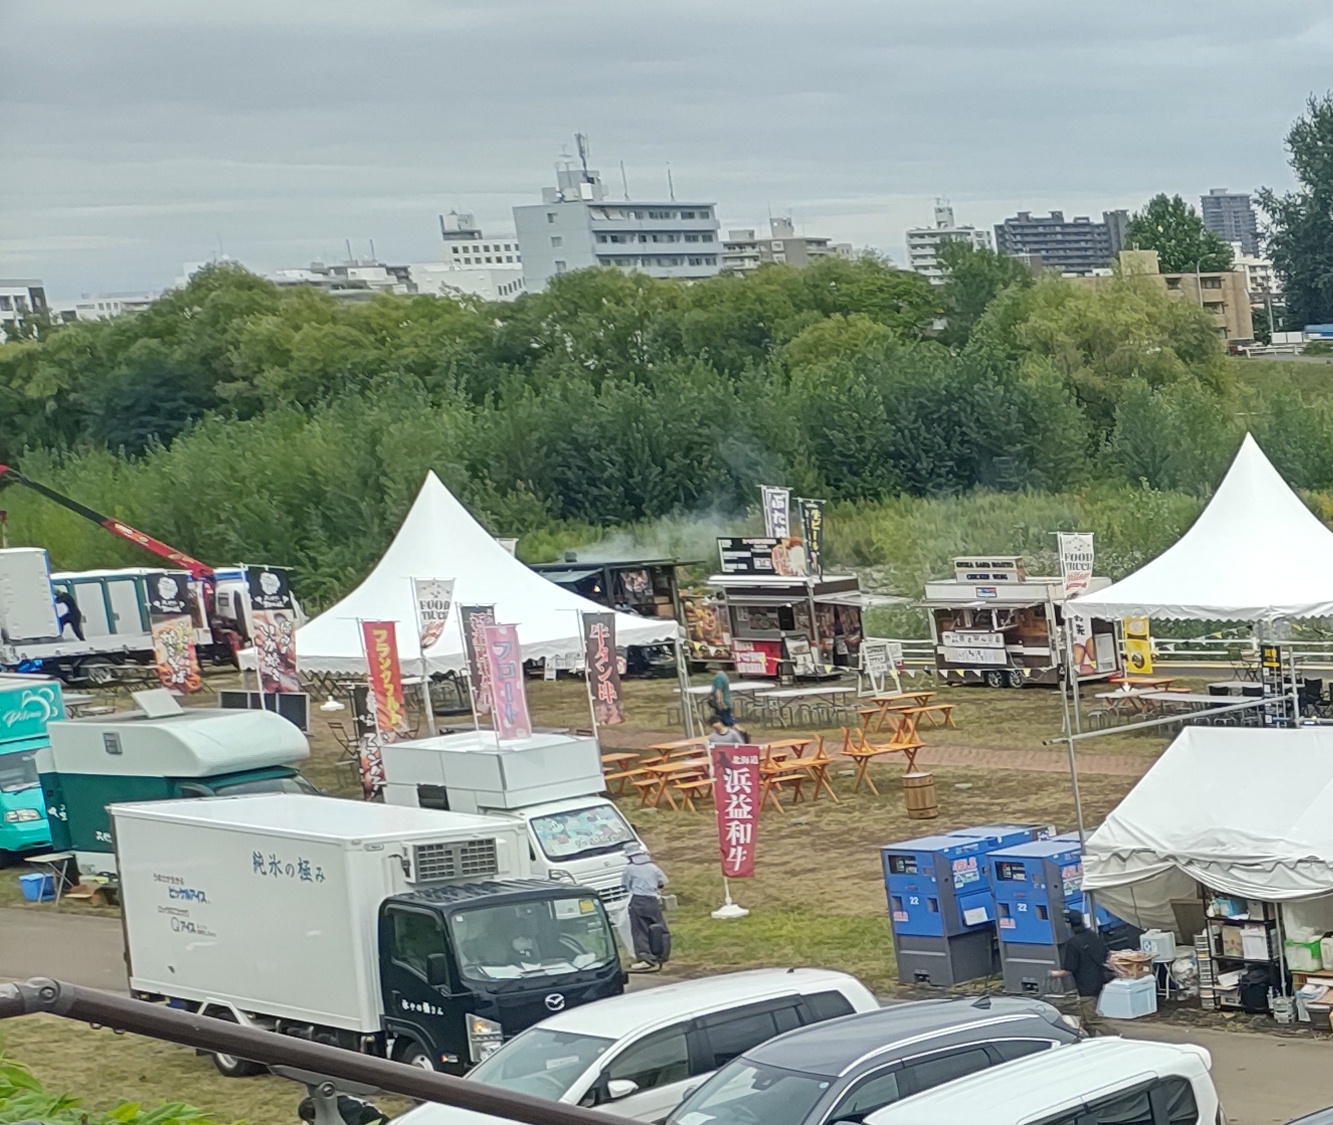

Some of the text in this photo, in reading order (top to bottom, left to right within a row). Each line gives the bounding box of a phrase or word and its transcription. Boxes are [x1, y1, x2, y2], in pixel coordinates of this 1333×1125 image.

[1064, 553, 1093, 562] FOOD
[1065, 562, 1092, 571] TRUCK
[419, 600, 451, 610] FOOD
[590, 623, 618, 705] 牛タン串
[372, 629, 402, 725] フランクフルト
[492, 640, 520, 726] フロート
[731, 755, 759, 765] 北海道
[723, 767, 754, 872] 浜益和牛
[252, 851, 326, 884] 純氷の極み
[909, 896, 919, 905] 22
[1017, 903, 1027, 912] 22
